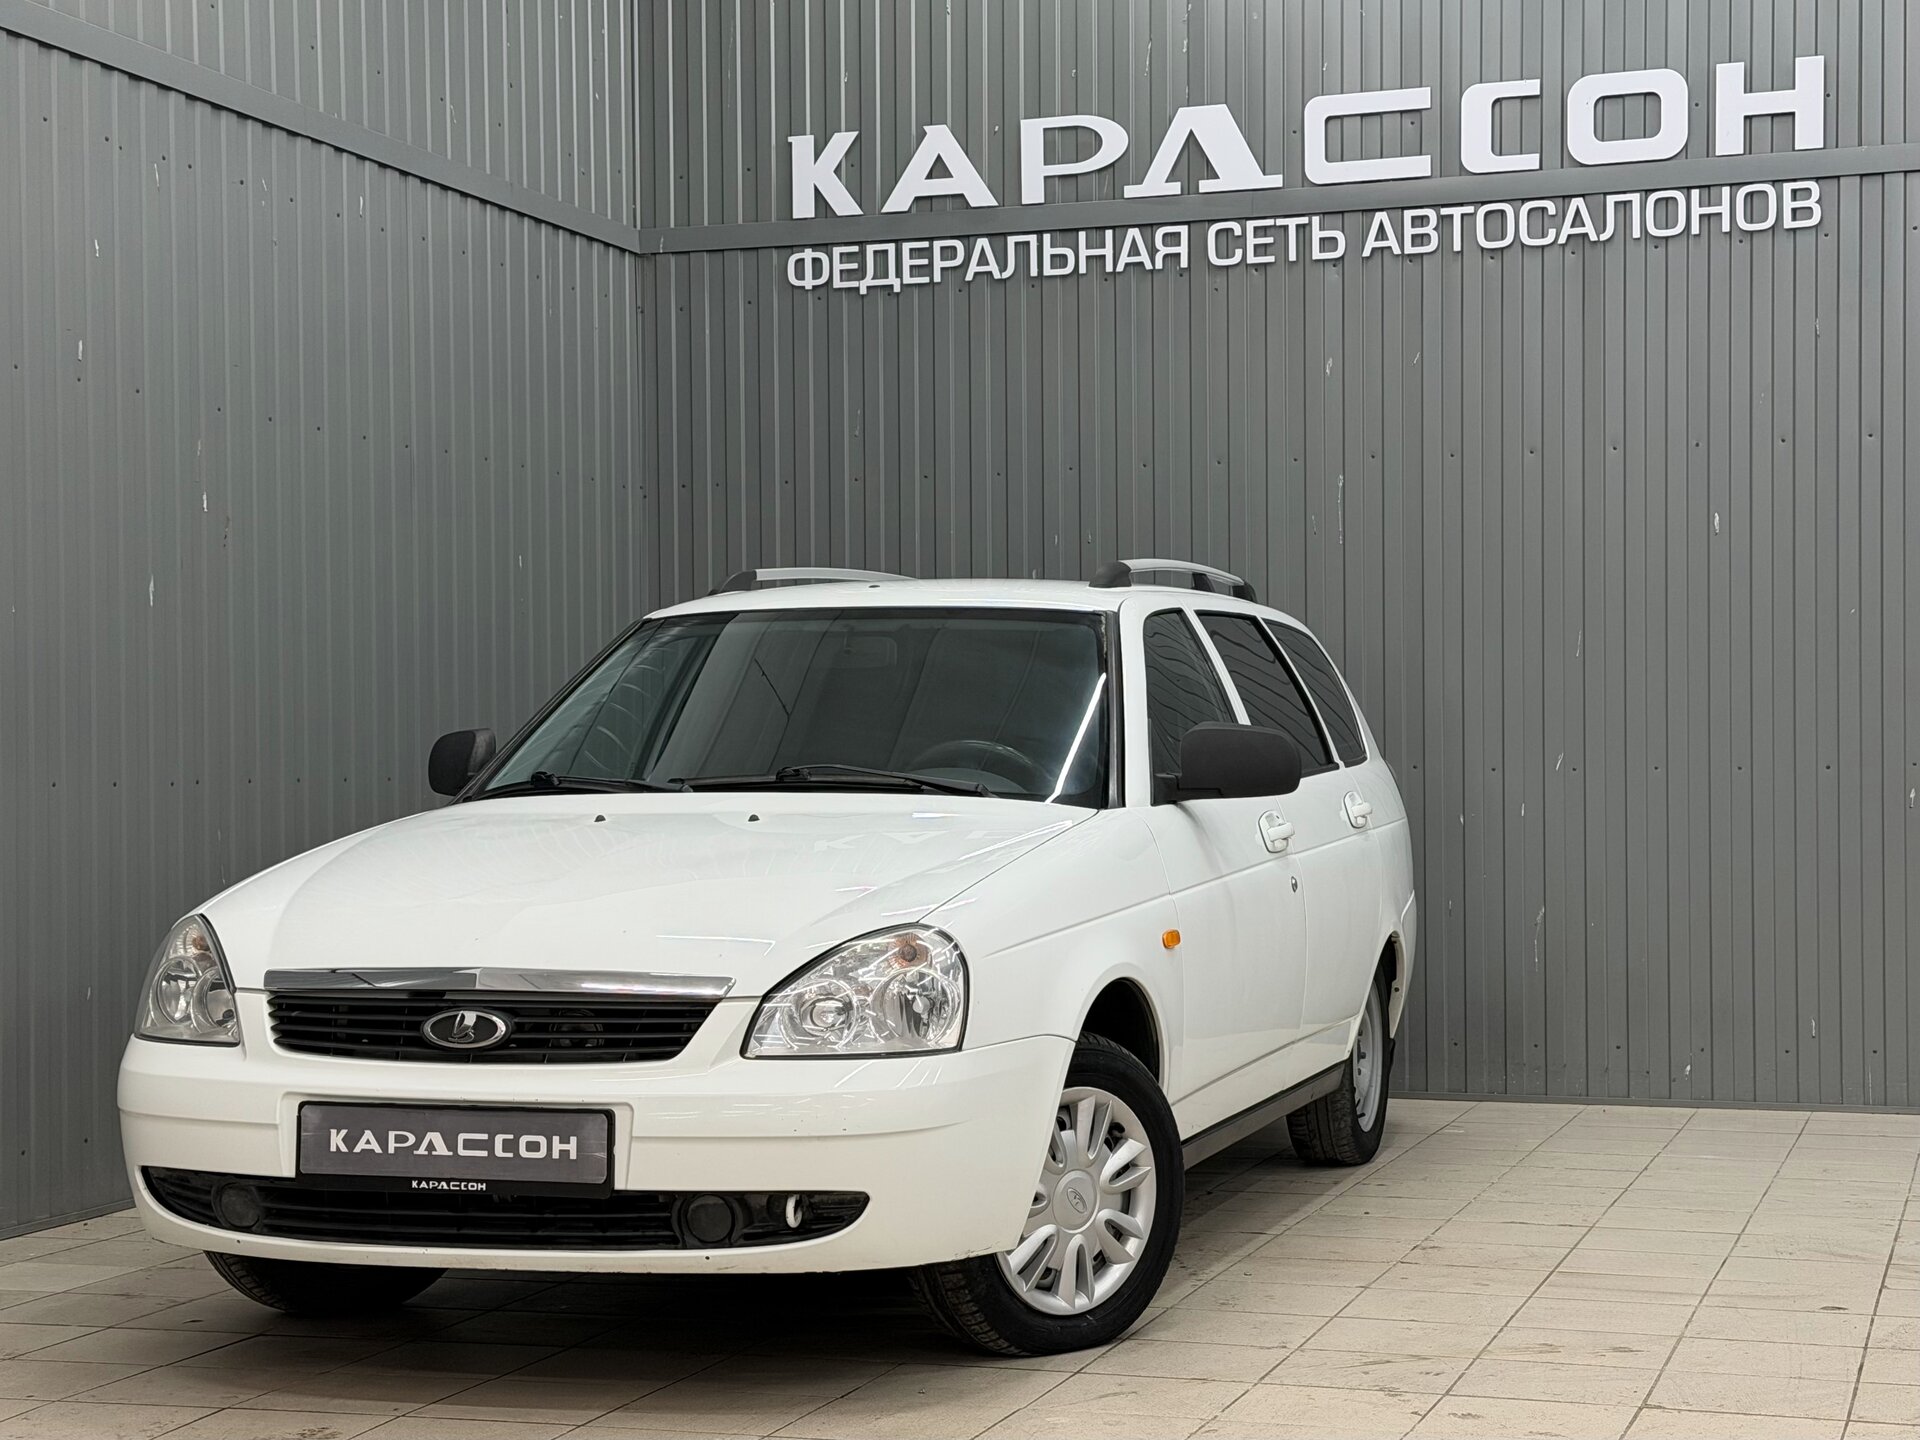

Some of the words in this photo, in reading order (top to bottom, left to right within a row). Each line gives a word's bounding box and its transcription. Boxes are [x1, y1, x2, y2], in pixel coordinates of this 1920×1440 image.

[786, 224, 1190, 295] ФЕДЕРАЛЬНАЯ
[1206, 215, 1347, 268] СЕТЬ
[1361, 180, 1823, 258] АВТОСАЛОНОВ
